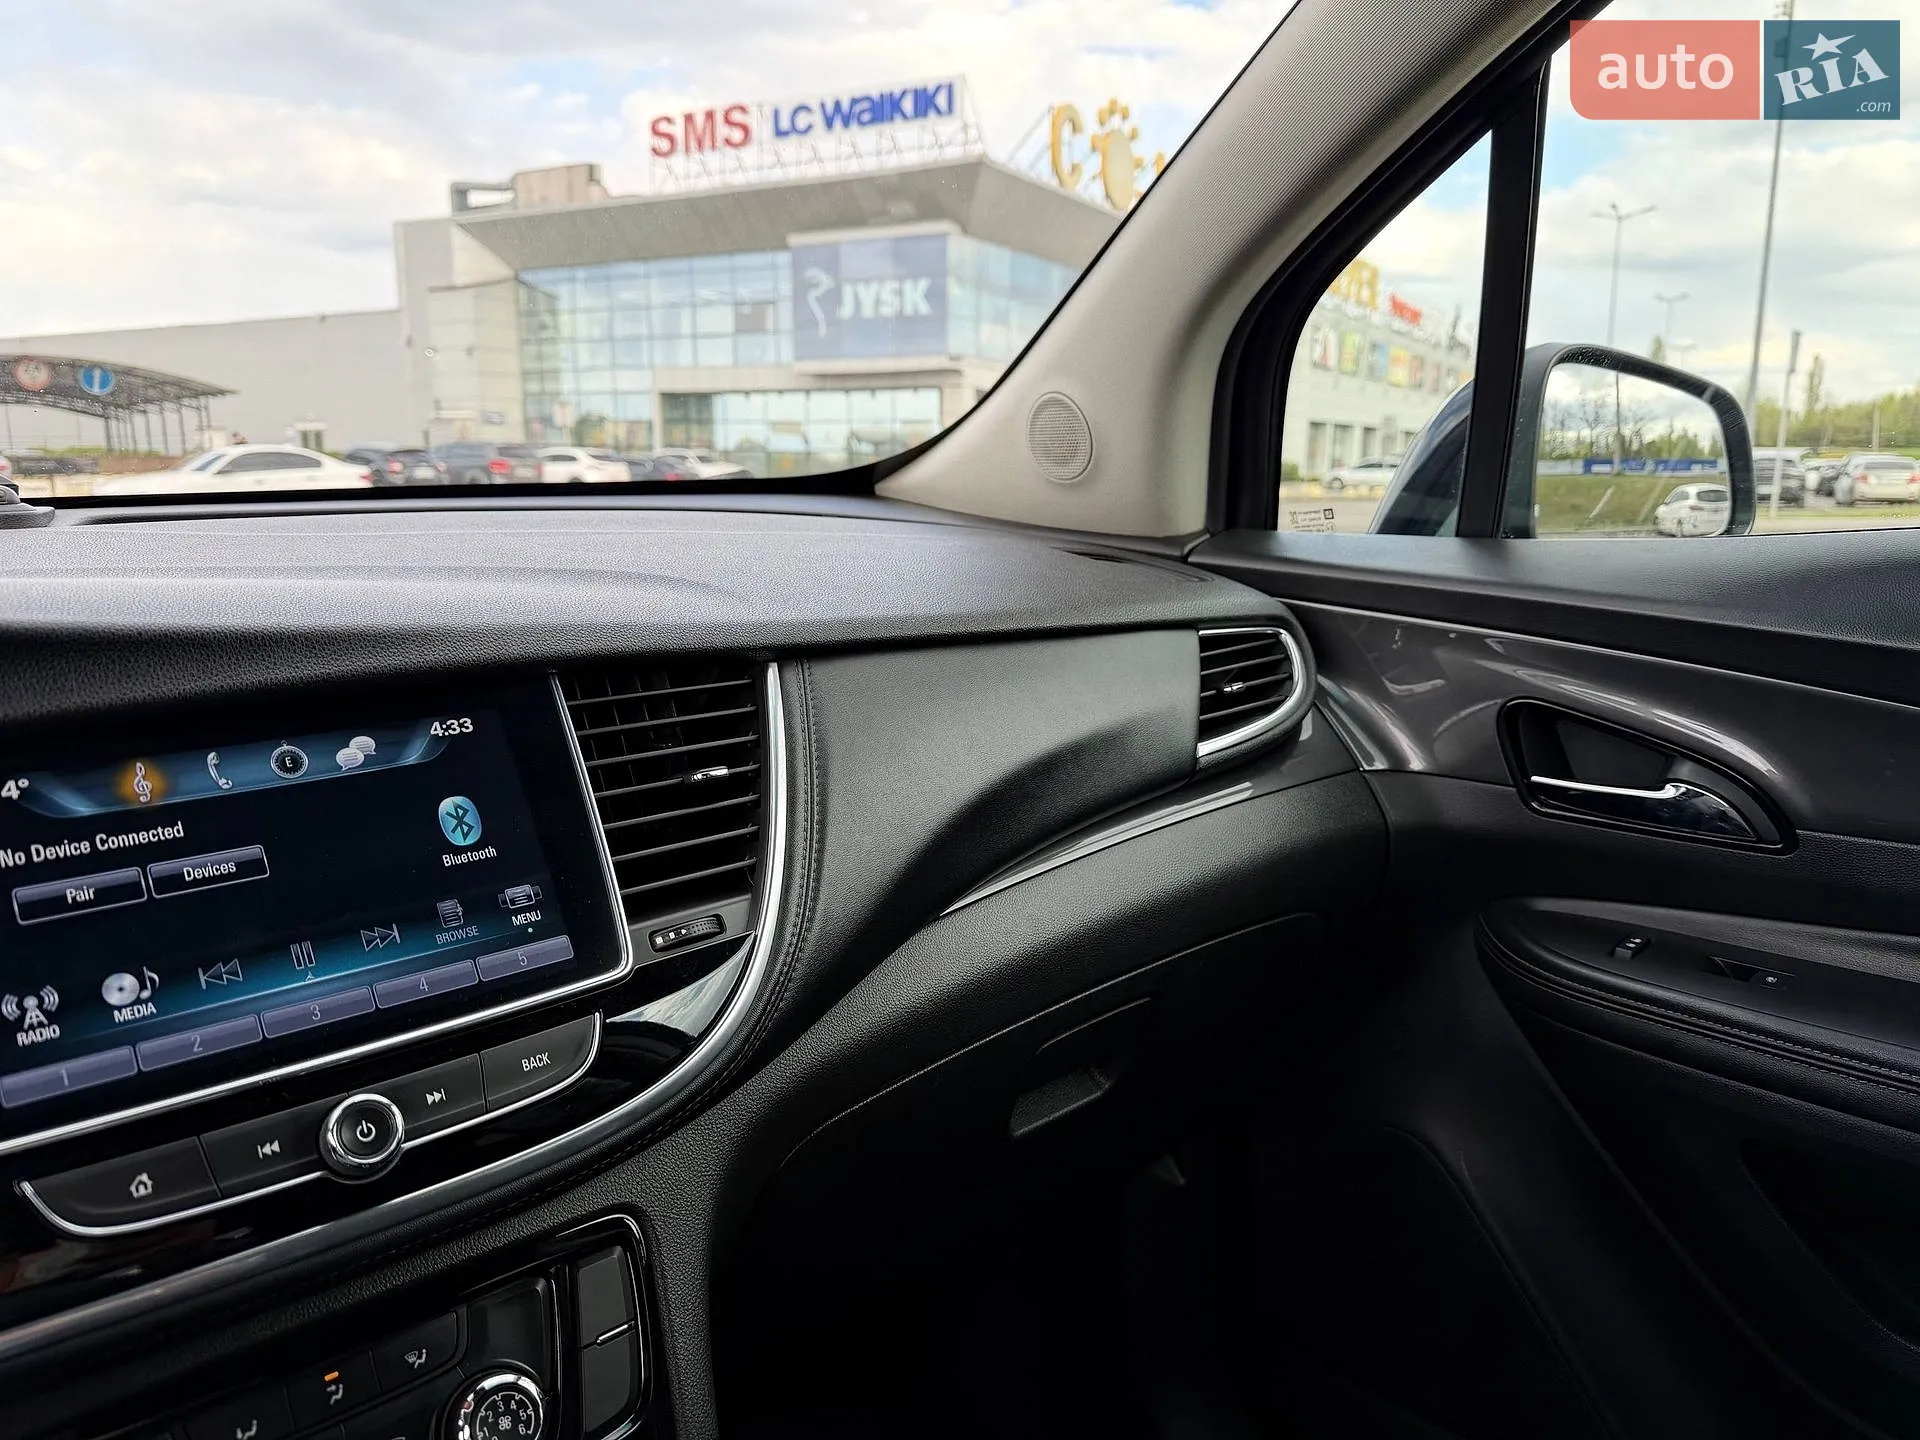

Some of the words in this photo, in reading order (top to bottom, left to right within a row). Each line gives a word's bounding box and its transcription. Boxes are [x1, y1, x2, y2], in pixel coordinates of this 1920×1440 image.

[650, 104, 750, 157] SMS
[773, 105, 813, 137] LC
[839, 277, 932, 320] JYSK
[429, 717, 474, 737] 4:33
[0, 849, 26, 869] No
[30, 838, 91, 863] Device
[95, 821, 184, 851] Connected
[442, 845, 498, 867] Bluetooth
[183, 860, 237, 882] Devices
[65, 886, 96, 905] Pair
[511, 909, 542, 927] MENU
[435, 924, 480, 945] BROWSE
[517, 951, 529, 967] 5
[419, 975, 430, 993] 4
[113, 1001, 157, 1024] MEDIA
[310, 1004, 322, 1022] 3
[16, 1023, 61, 1047] RADIO
[190, 1034, 203, 1053] 2
[521, 1051, 552, 1072] BACK
[60, 1068, 70, 1087] 1
[497, 1401, 505, 1412] 3
[510, 1400, 517, 1410] 4
[519, 1409, 526, 1420] 5
[487, 1411, 494, 1422] 2
[518, 1424, 526, 1435] 6
